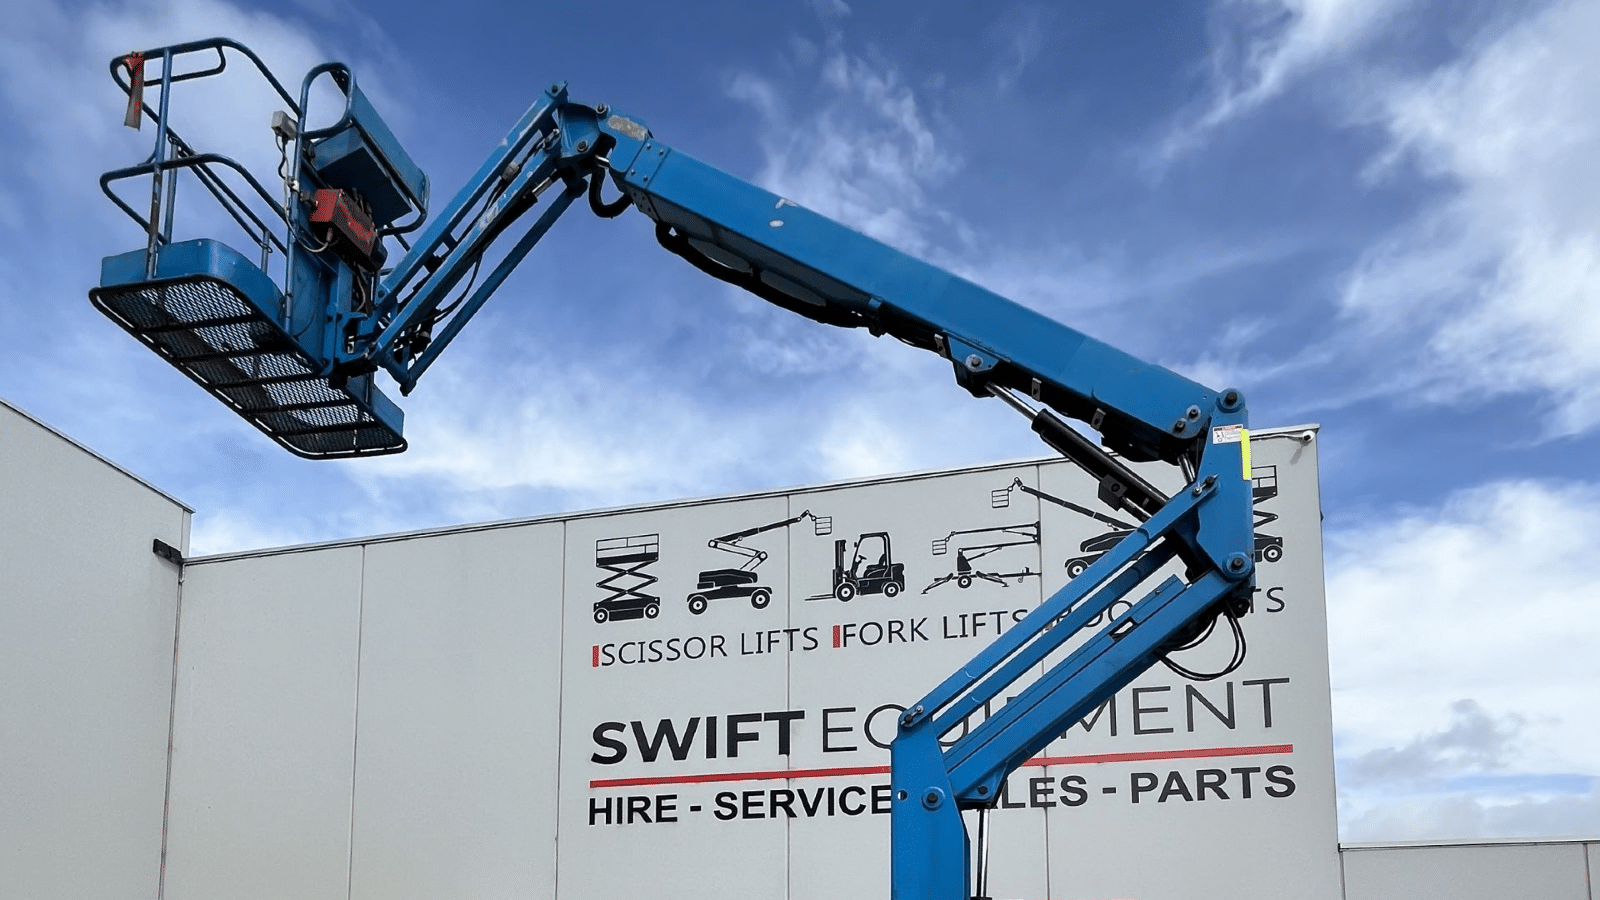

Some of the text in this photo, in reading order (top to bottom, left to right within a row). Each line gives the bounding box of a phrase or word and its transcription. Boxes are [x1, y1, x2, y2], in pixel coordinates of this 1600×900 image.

[601, 626, 819, 667] SCISSOR LIFTS
[842, 617, 929, 648] FORK
[590, 709, 806, 765] SWIFT
[588, 793, 679, 826] HIRE
[713, 784, 892, 821] SERVICE
[1130, 764, 1297, 804] PARTS
